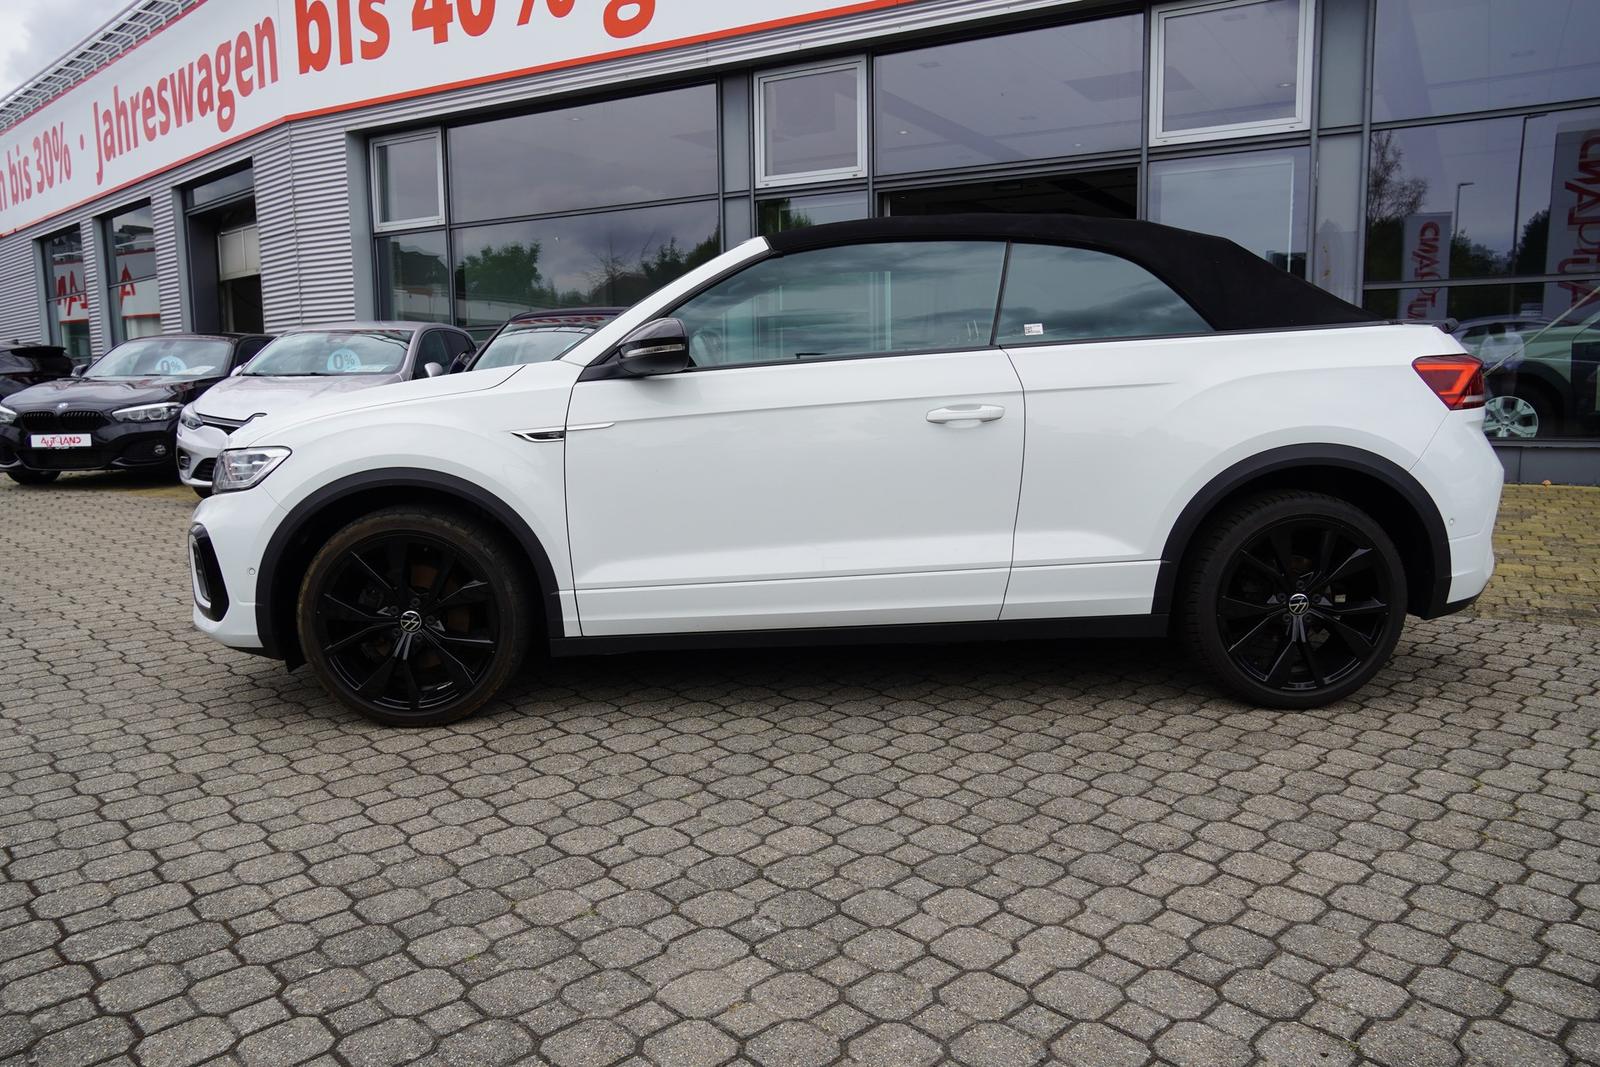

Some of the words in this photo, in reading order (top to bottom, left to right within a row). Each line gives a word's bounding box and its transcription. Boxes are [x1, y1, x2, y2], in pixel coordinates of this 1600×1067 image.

[7, 144, 32, 207] bis
[33, 121, 72, 194] 30%
[93, 16, 279, 186] Jahreswagen
[294, 0, 390, 75] bis
[332, 351, 355, 370] 0%
